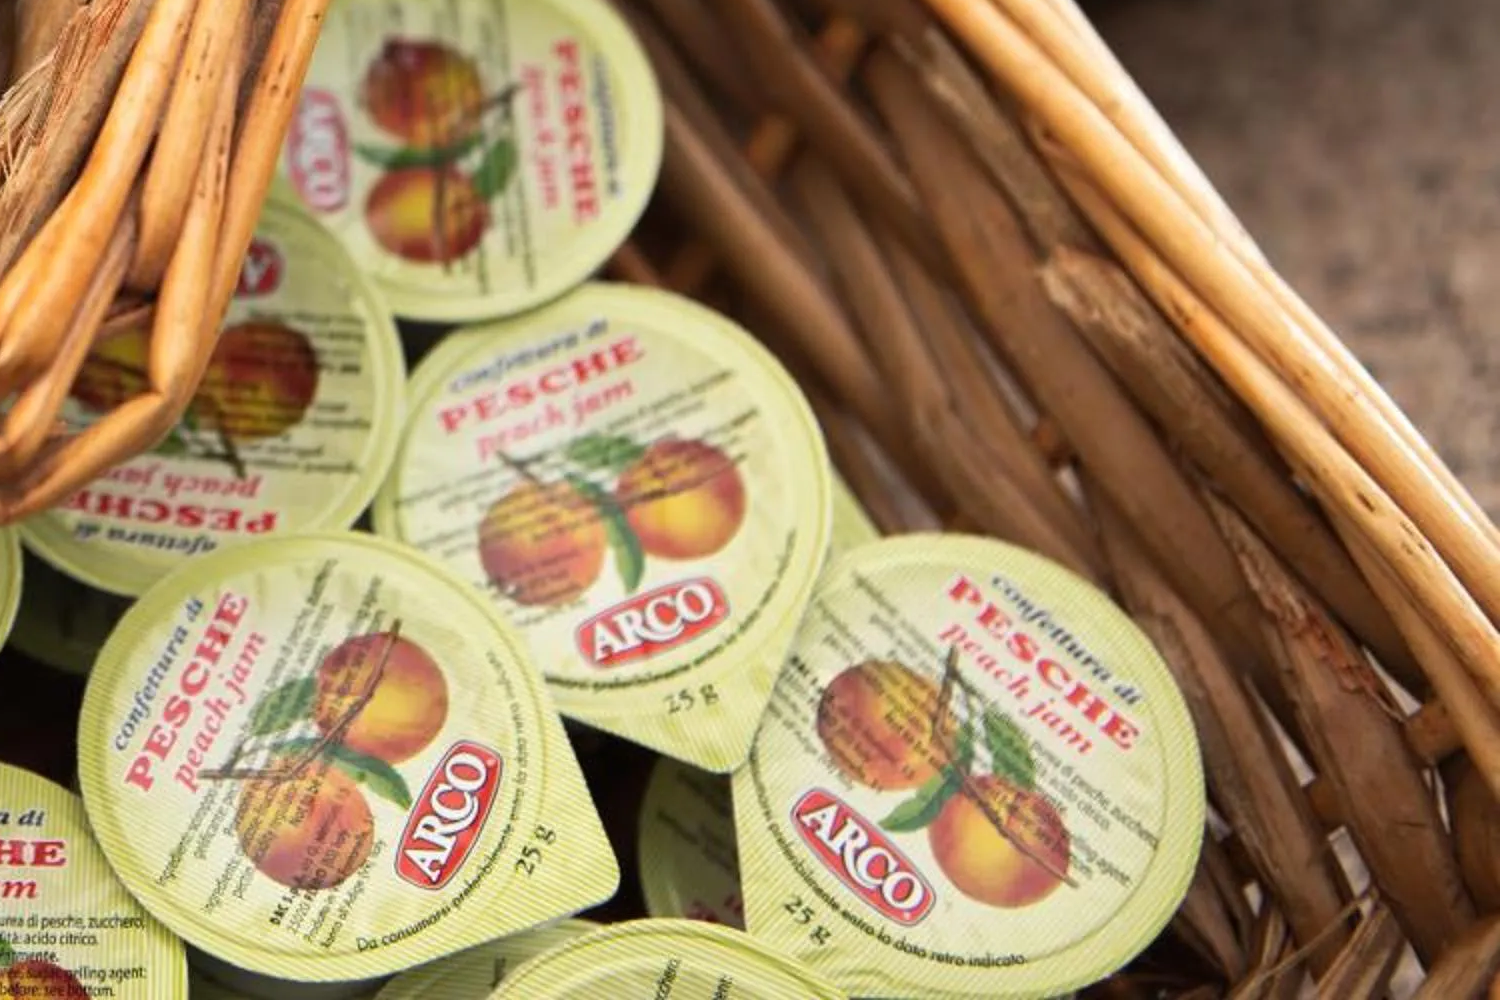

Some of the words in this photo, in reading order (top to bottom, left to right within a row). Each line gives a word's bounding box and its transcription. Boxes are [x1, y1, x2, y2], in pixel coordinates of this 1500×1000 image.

[440, 337, 645, 433] PESCHE
[593, 585, 715, 660] ARCO
[948, 577, 1139, 750] PESCHE
[991, 575, 1116, 685] confettura
[1114, 682, 1141, 706] di
[114, 626, 187, 751] confettura
[186, 601, 204, 624] di
[123, 592, 247, 792] PESCHE
[173, 697, 230, 794] peach
[222, 633, 267, 705] jam
[938, 622, 1029, 697] peach
[1023, 699, 1092, 754] jam
[18, 810, 43, 826] di
[403, 753, 488, 882] ARCO
[514, 847, 541, 876] 25
[536, 825, 557, 843] g
[801, 805, 924, 910] ARCO
[21, 932, 57, 944] acido
[59, 933, 98, 945] citrico.
[27, 914, 39, 927] di
[784, 896, 814, 921] 25
[811, 924, 832, 946] g
[108, 967, 147, 983] agent:
